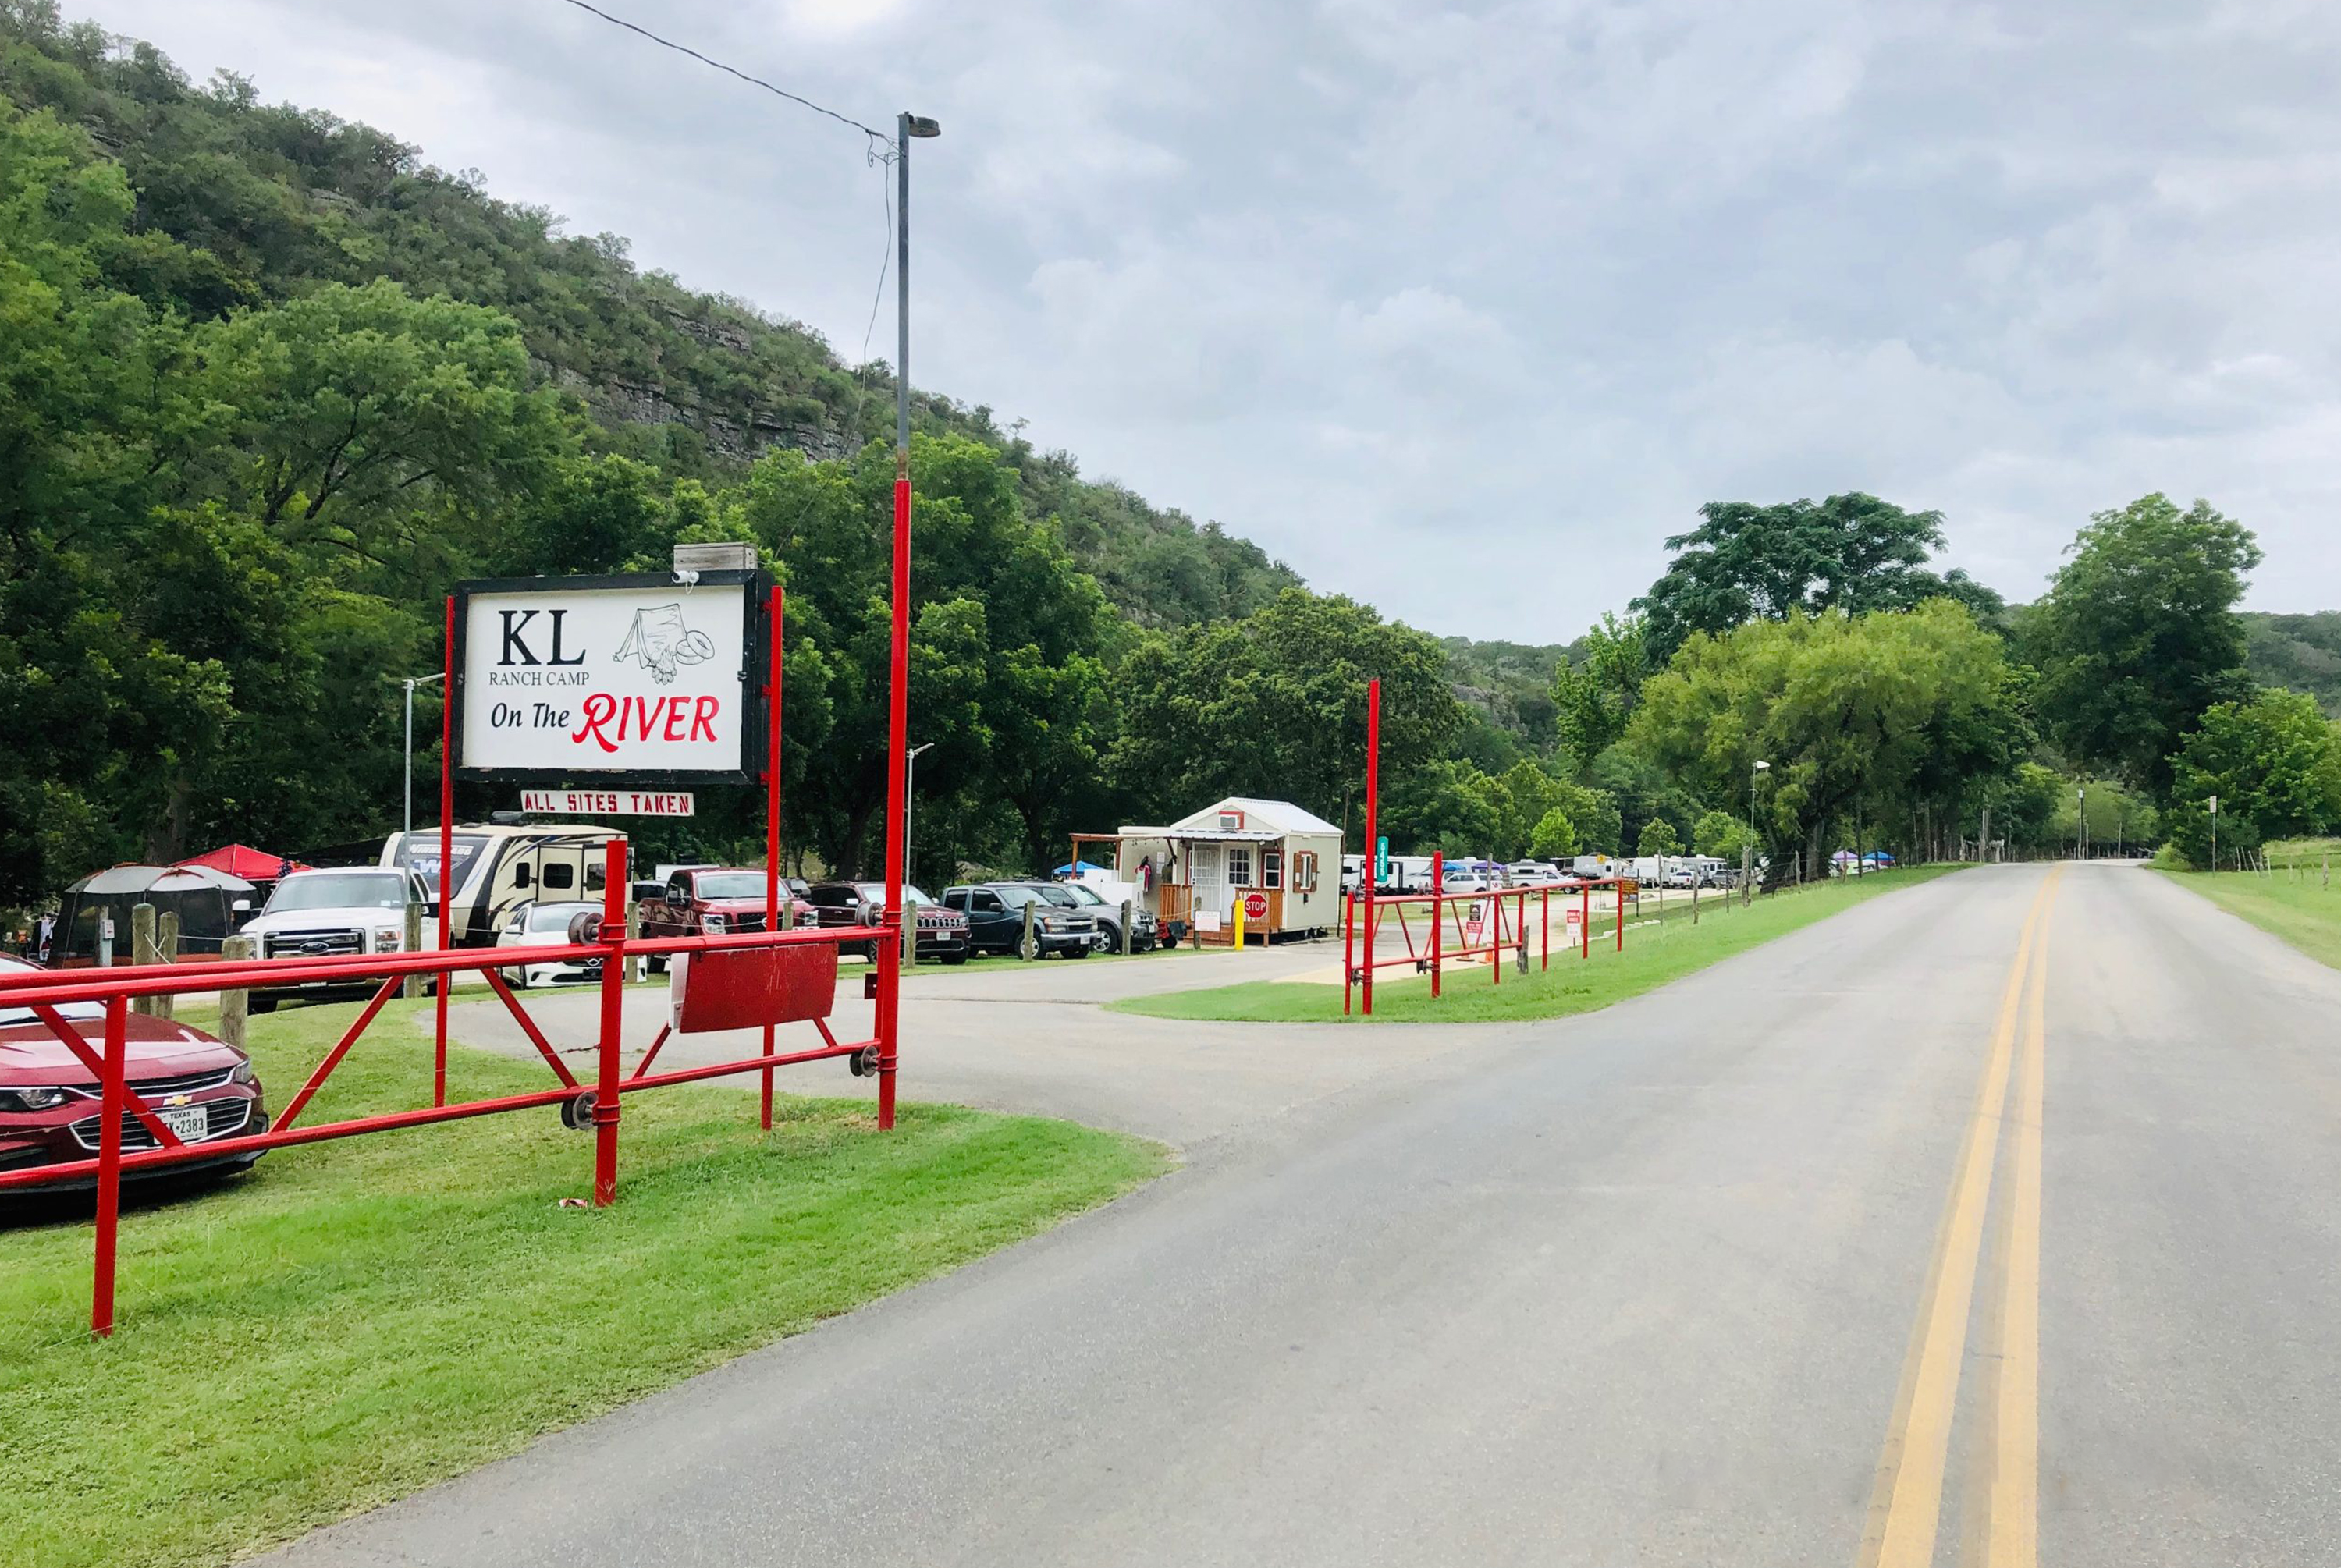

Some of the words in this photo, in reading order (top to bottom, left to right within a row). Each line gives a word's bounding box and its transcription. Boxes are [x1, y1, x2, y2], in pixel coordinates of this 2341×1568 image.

[497, 610, 586, 665] KL
[489, 672, 541, 686] RANCH
[546, 672, 589, 686] CAMP
[491, 702, 522, 728] On
[533, 702, 569, 728] The
[572, 693, 719, 753] RIVER
[525, 793, 555, 811] ALL
[567, 794, 618, 813] SITES
[631, 794, 690, 814] TAKEN
[1245, 901, 1266, 911] STOP
